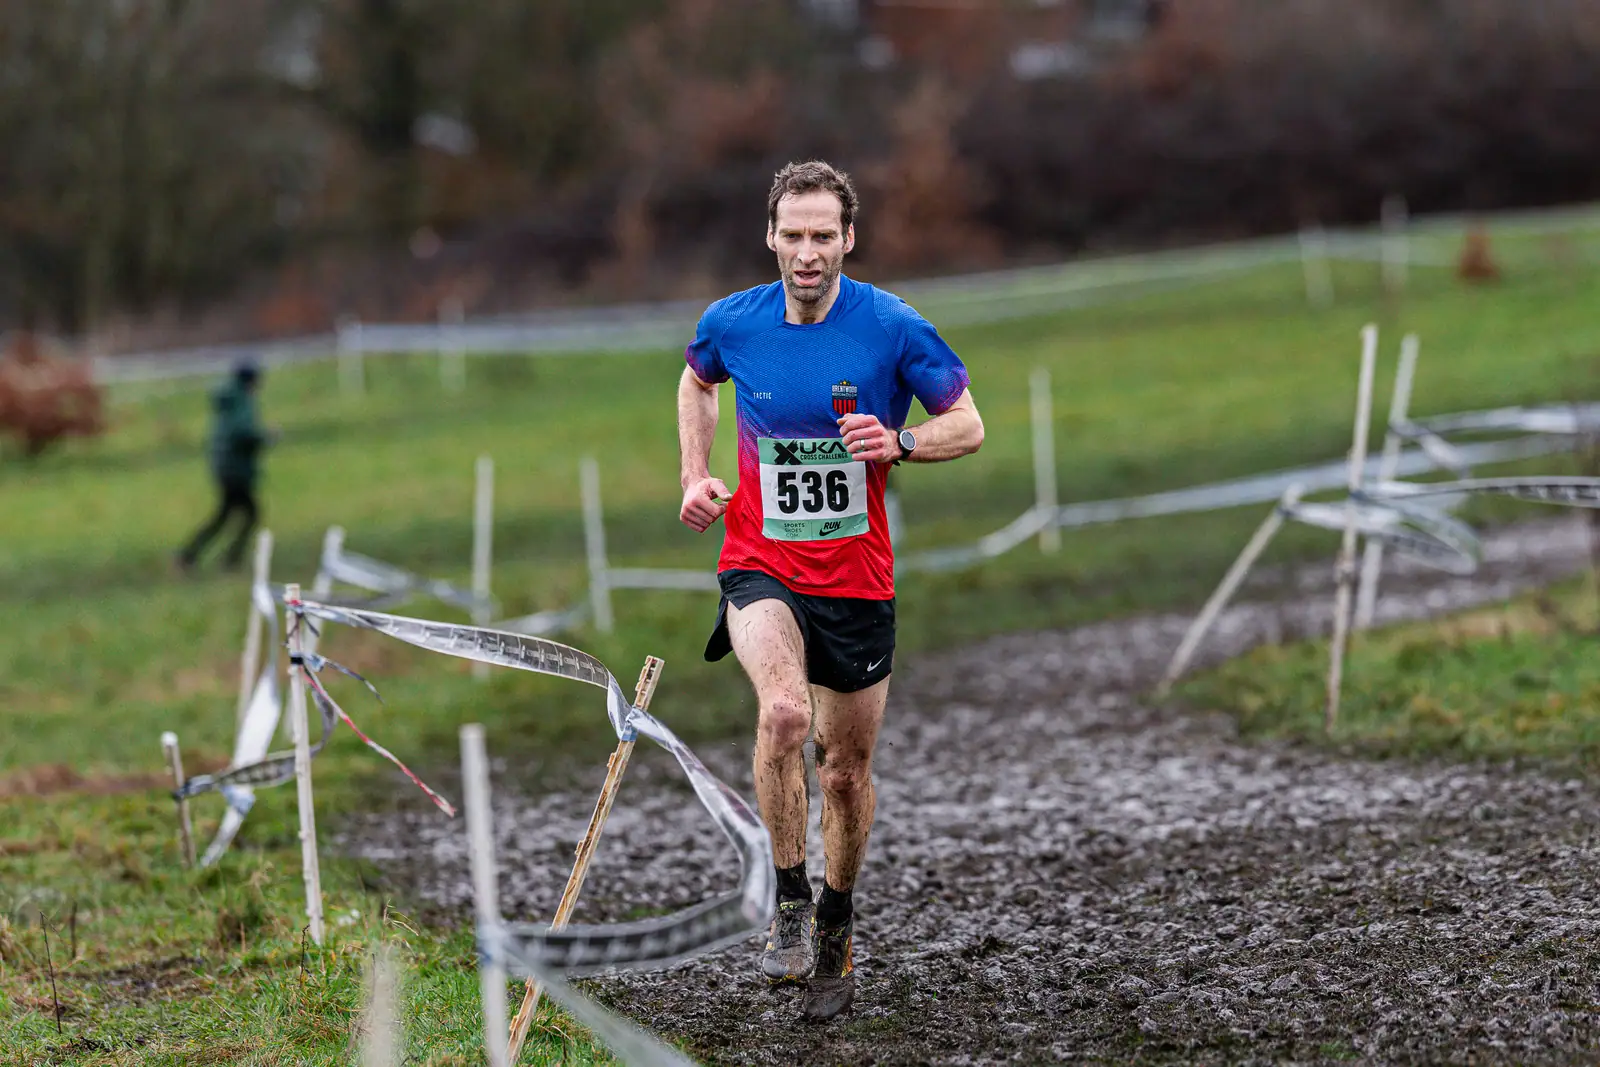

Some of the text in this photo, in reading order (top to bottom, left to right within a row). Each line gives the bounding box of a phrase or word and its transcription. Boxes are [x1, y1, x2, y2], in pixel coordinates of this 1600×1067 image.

[753, 392, 772, 400] TACTIC
[818, 452, 849, 461] CHALLENGE
[777, 470, 850, 514] 536
[823, 521, 842, 530] RUN
